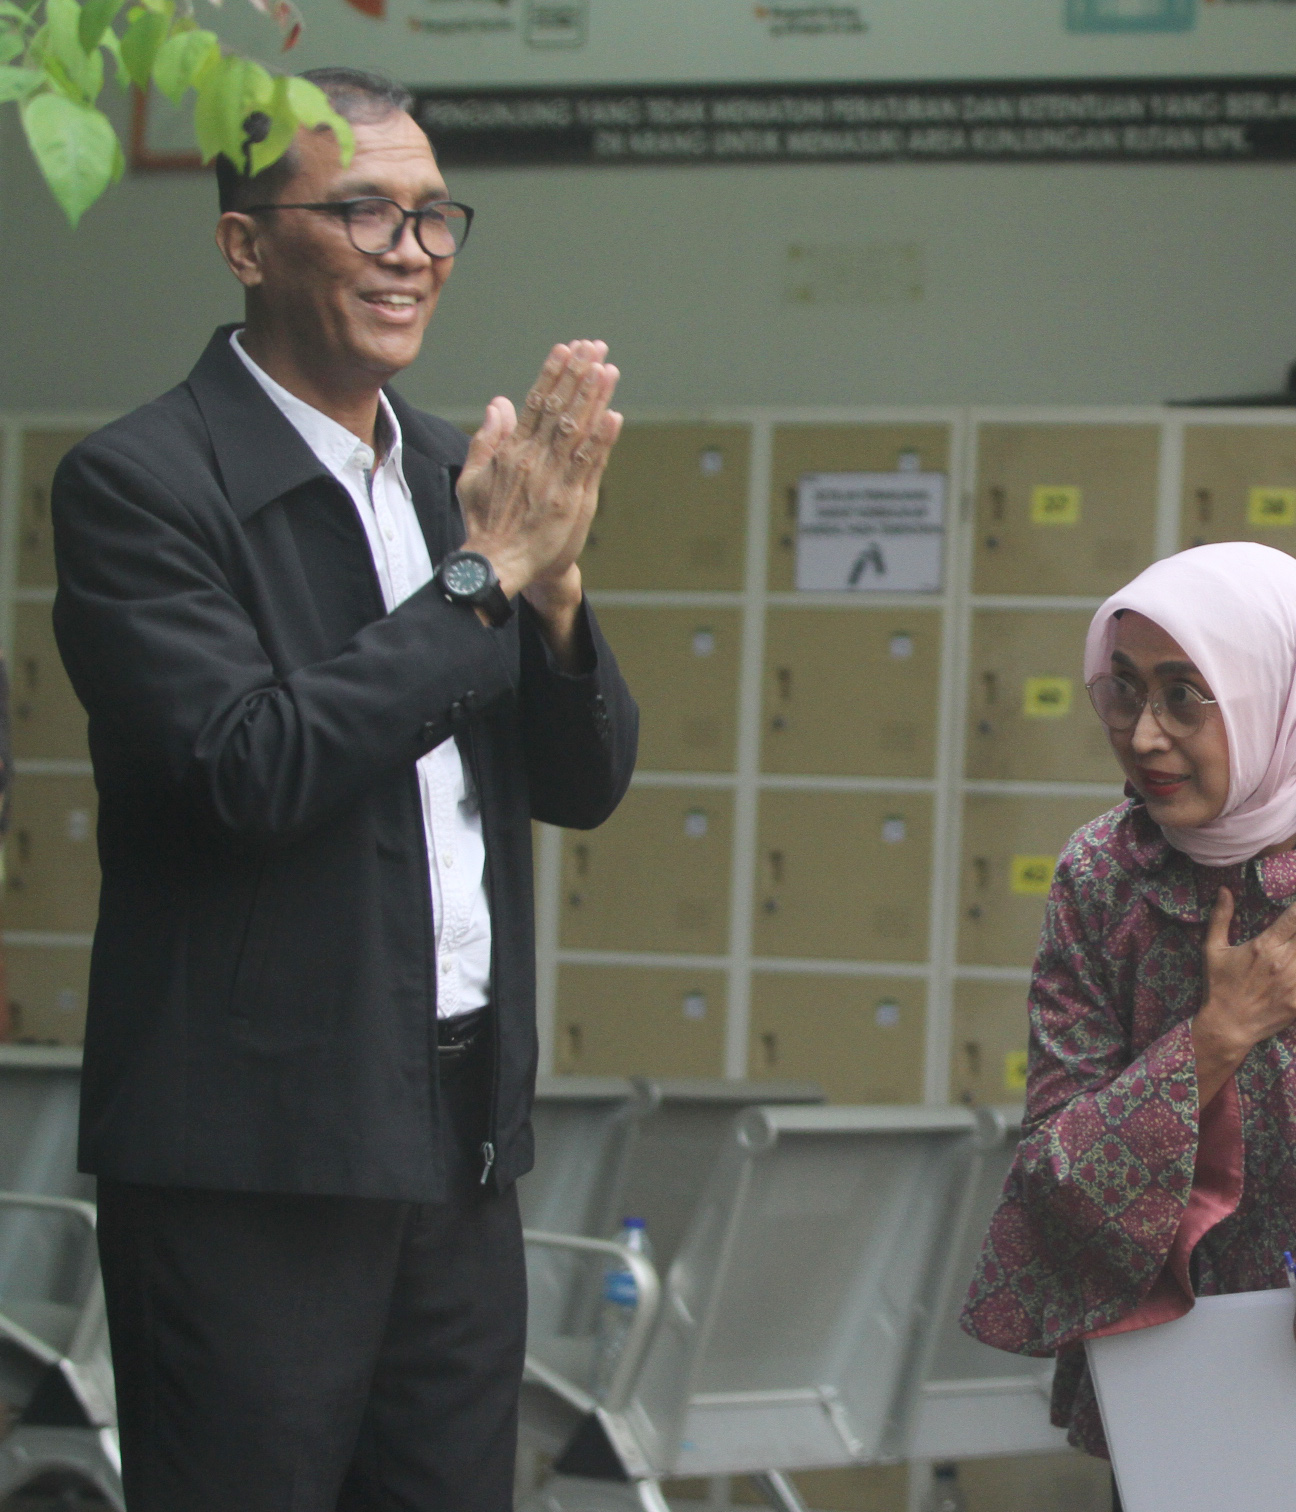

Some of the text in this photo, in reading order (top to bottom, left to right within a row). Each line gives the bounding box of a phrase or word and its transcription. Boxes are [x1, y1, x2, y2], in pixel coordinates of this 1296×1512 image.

[577, 98, 641, 125] YANG
[831, 96, 957, 121] PERATURAN
[962, 96, 1013, 120] DAN
[1151, 94, 1219, 119] YANG
[909, 129, 965, 153] AREA
[1124, 127, 1197, 151] RUTAN
